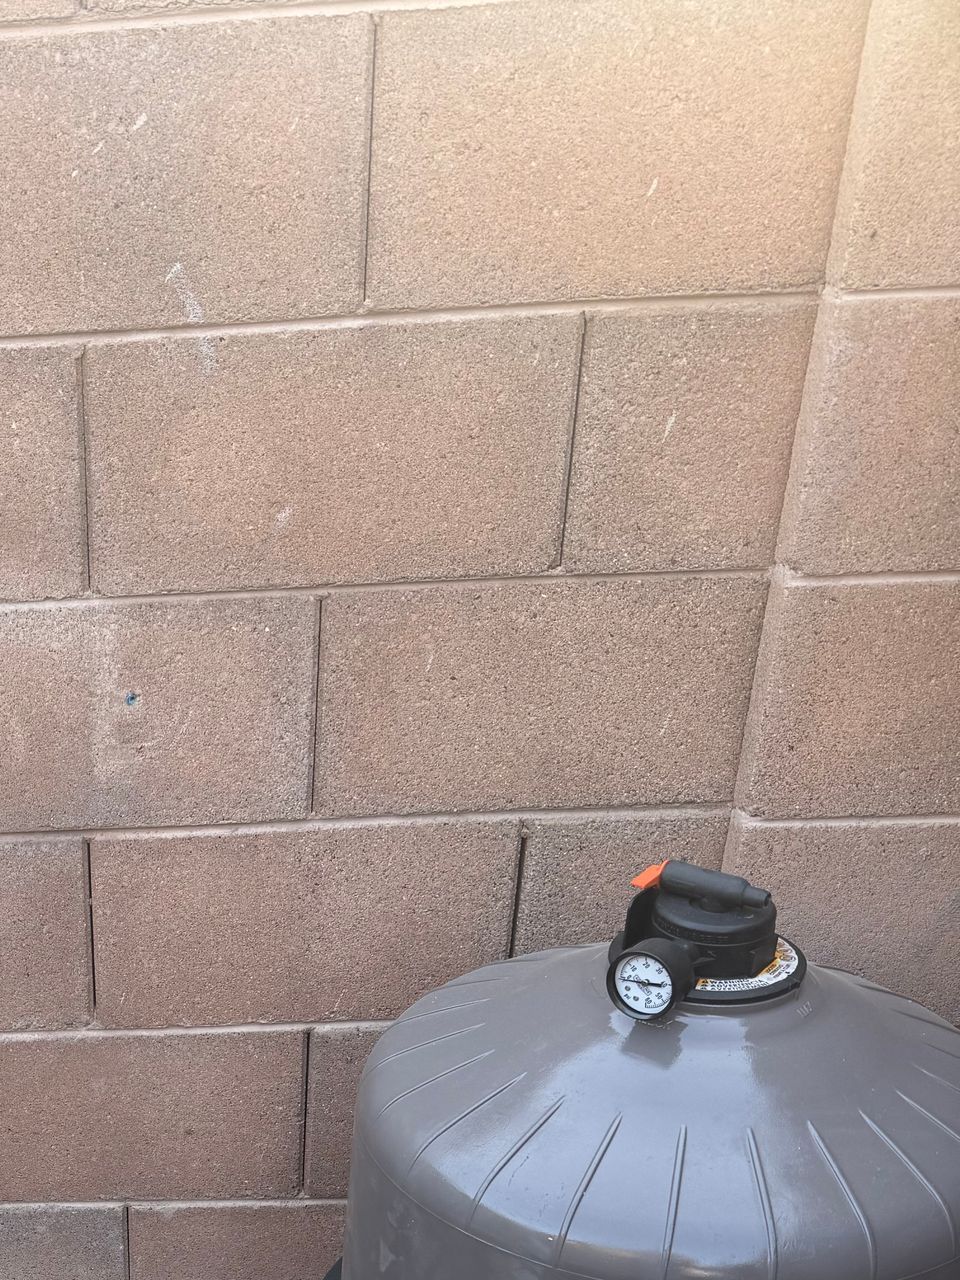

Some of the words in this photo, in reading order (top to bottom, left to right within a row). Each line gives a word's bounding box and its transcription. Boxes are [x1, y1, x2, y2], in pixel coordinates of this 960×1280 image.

[655, 966, 664, 975] 30
[654, 992, 663, 1000] 50
[644, 997, 653, 1005] 60
